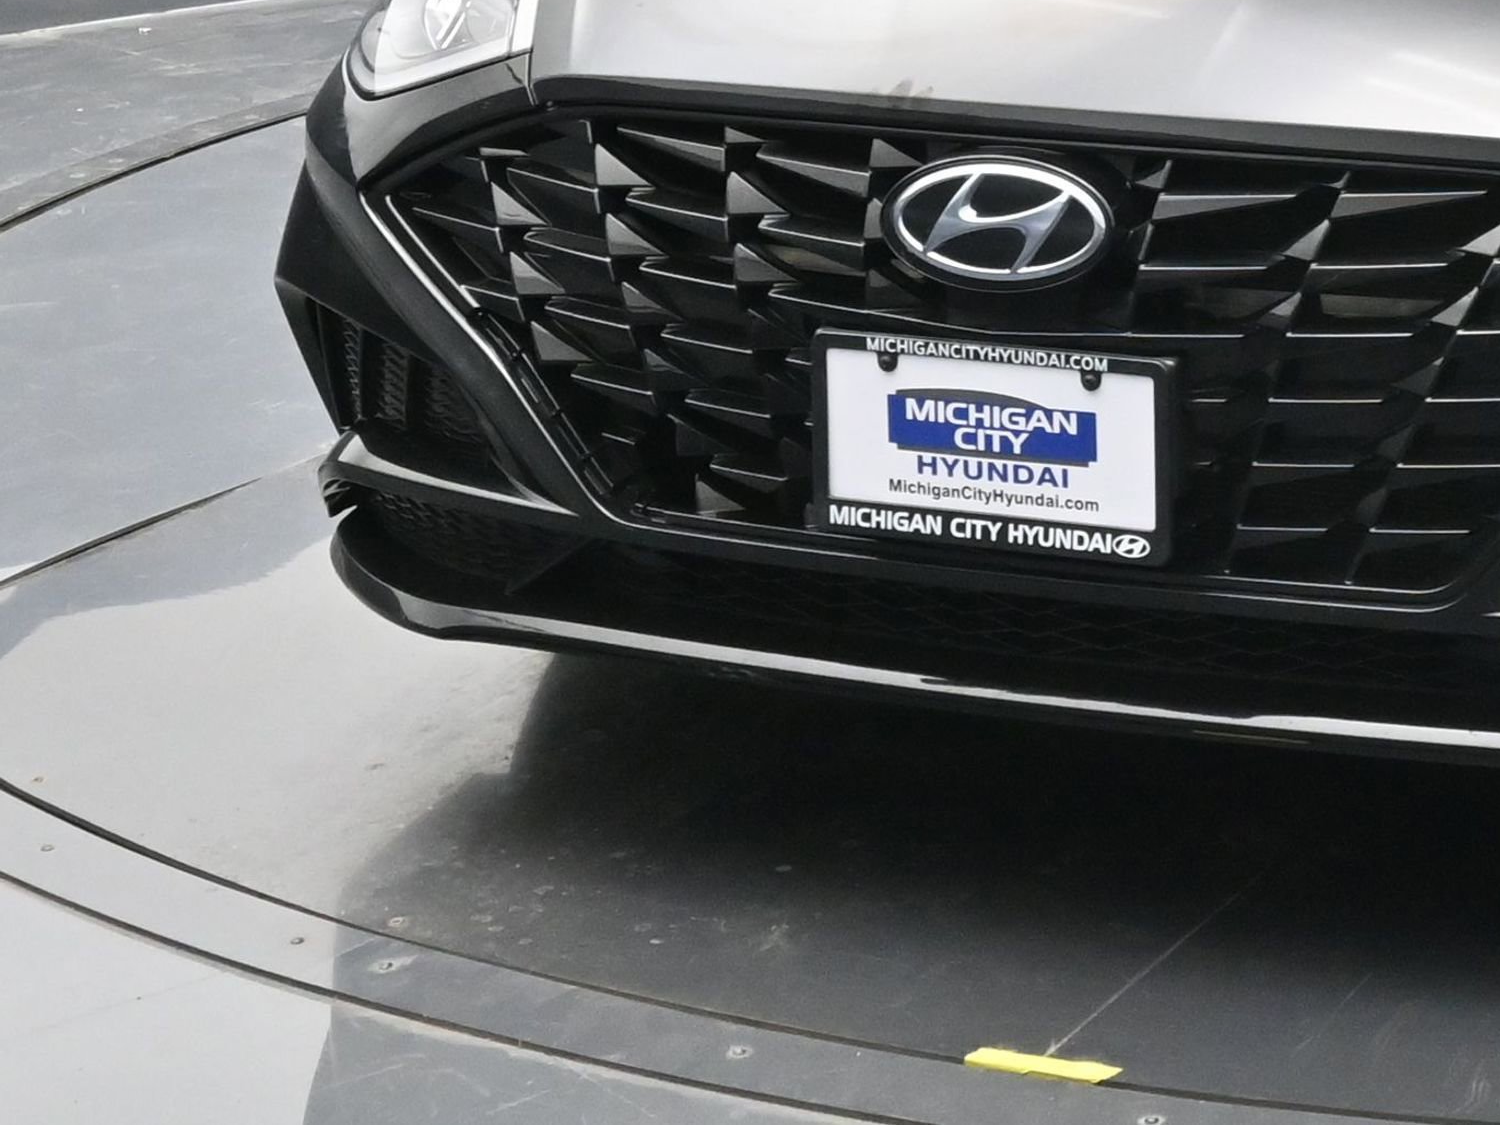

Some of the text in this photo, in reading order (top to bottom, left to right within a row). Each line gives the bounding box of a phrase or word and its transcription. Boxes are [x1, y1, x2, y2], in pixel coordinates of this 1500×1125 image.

[866, 337, 1108, 372] MICHIGANCITYHYUNDAI.COM
[905, 397, 1078, 435] MICHIGAN
[954, 427, 1029, 454] CITY
[917, 455, 1069, 488] HYUNDAI
[889, 478, 1100, 512] MichiganCityHyundai.com
[829, 504, 1113, 555] MICHIGAN CITY HYUNDAI
